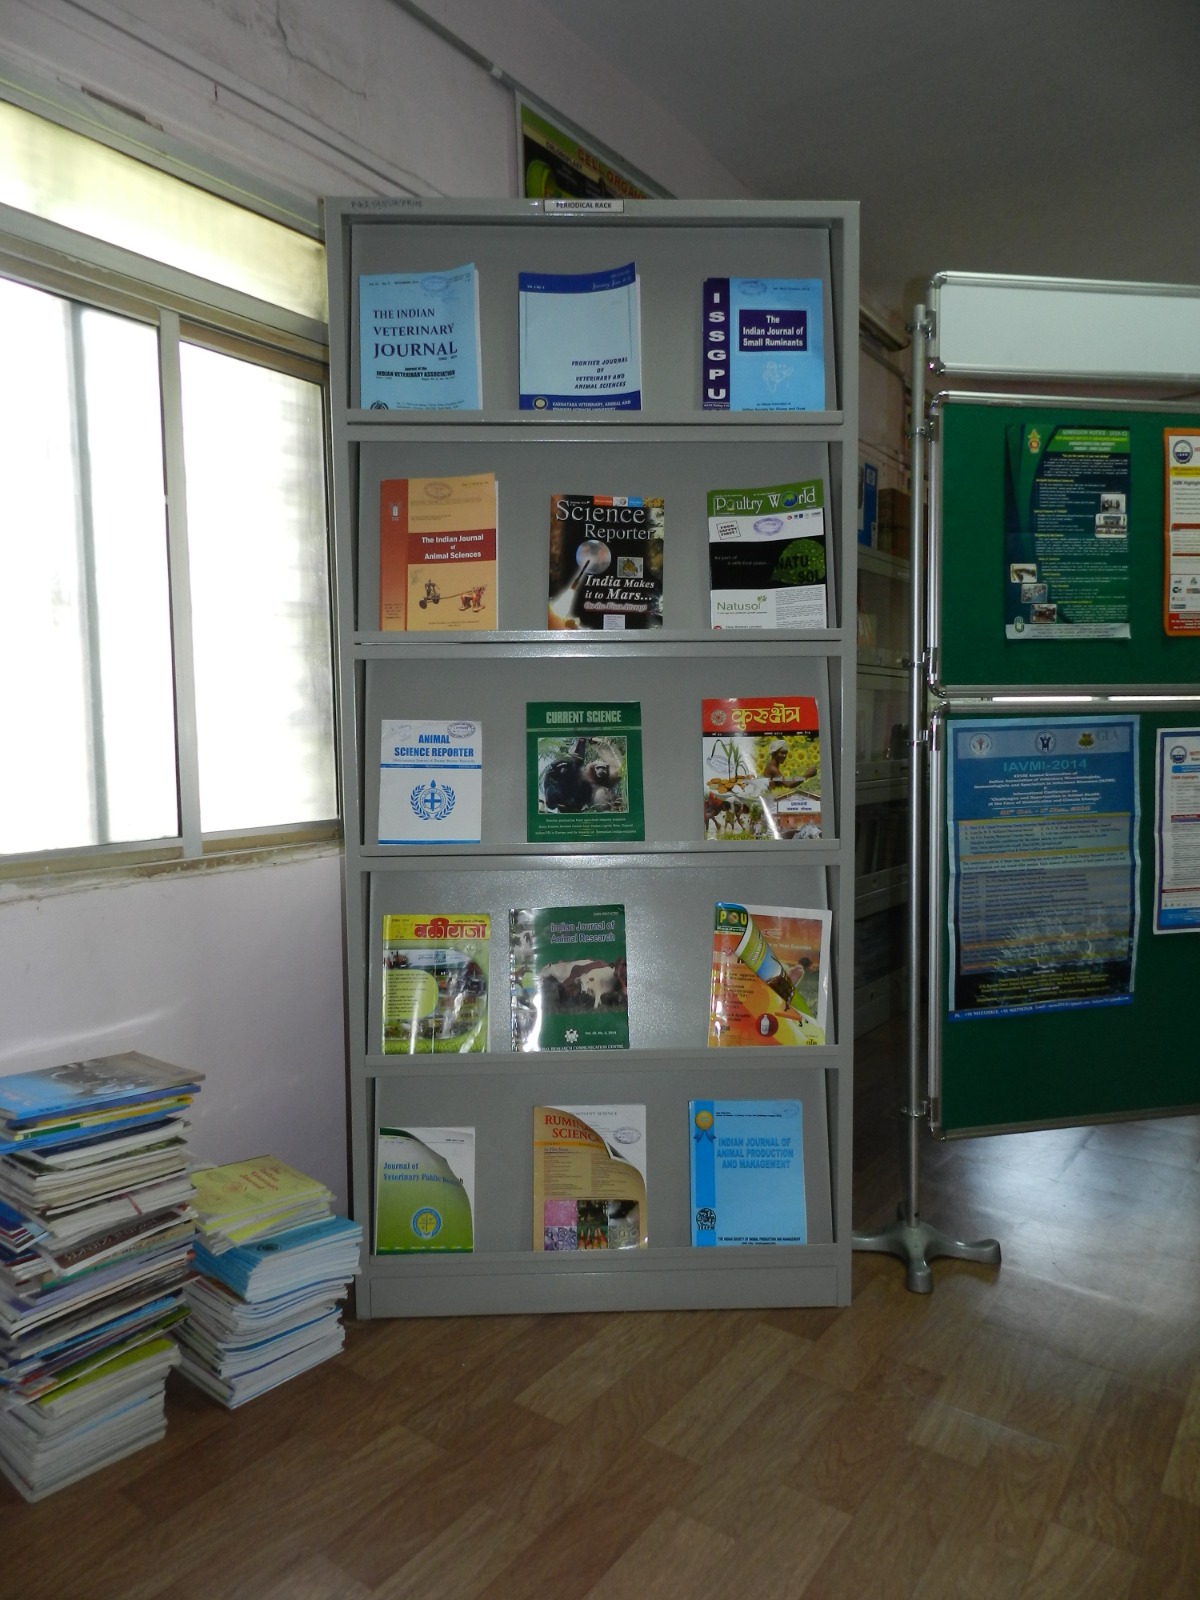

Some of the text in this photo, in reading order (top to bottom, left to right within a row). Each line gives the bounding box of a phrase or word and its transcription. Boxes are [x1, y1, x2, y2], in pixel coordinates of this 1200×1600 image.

[373, 308, 435, 319] THE INDIAN
[766, 315, 780, 323] The
[374, 323, 454, 336] VETERINARY
[743, 326, 804, 335] Indian Journal of
[743, 338, 803, 346] Small Ruminants
[374, 341, 457, 359] JOURNAL
[602, 356, 628, 365] JOURNAL
[424, 369, 455, 377] ASSOCIATION
[576, 374, 611, 382] VETERINARY
[599, 381, 626, 389] SCIENCES
[714, 487, 815, 515] Poultry World
[556, 499, 646, 523] Science
[584, 524, 653, 542] Reporter
[421, 533, 484, 544] The Indian Journal
[424, 550, 482, 560] Animal Sciences
[585, 574, 654, 588] India Makes
[585, 588, 652, 601] it to Mars...
[717, 599, 761, 611] Natusol
[546, 710, 622, 724] CURRENT SCIENCE
[731, 702, 800, 731] कुरुक्षेत्र
[418, 734, 450, 744] ANIMAL
[394, 747, 474, 757] SCIENCE REPORTER
[1003, 758, 1087, 773] IAVMI-2014
[550, 919, 615, 932] Indian Journal of
[550, 932, 615, 944] Animal Research
[718, 1137, 791, 1147] INDIAN JOURNAL OF
[716, 1148, 794, 1158] ANIMAL PRODUCTION
[383, 1162, 410, 1170] Journal
[722, 1159, 791, 1169] AND MANAGEMENT
[383, 1173, 419, 1182] Veterinary
[421, 1173, 442, 1182] Public
